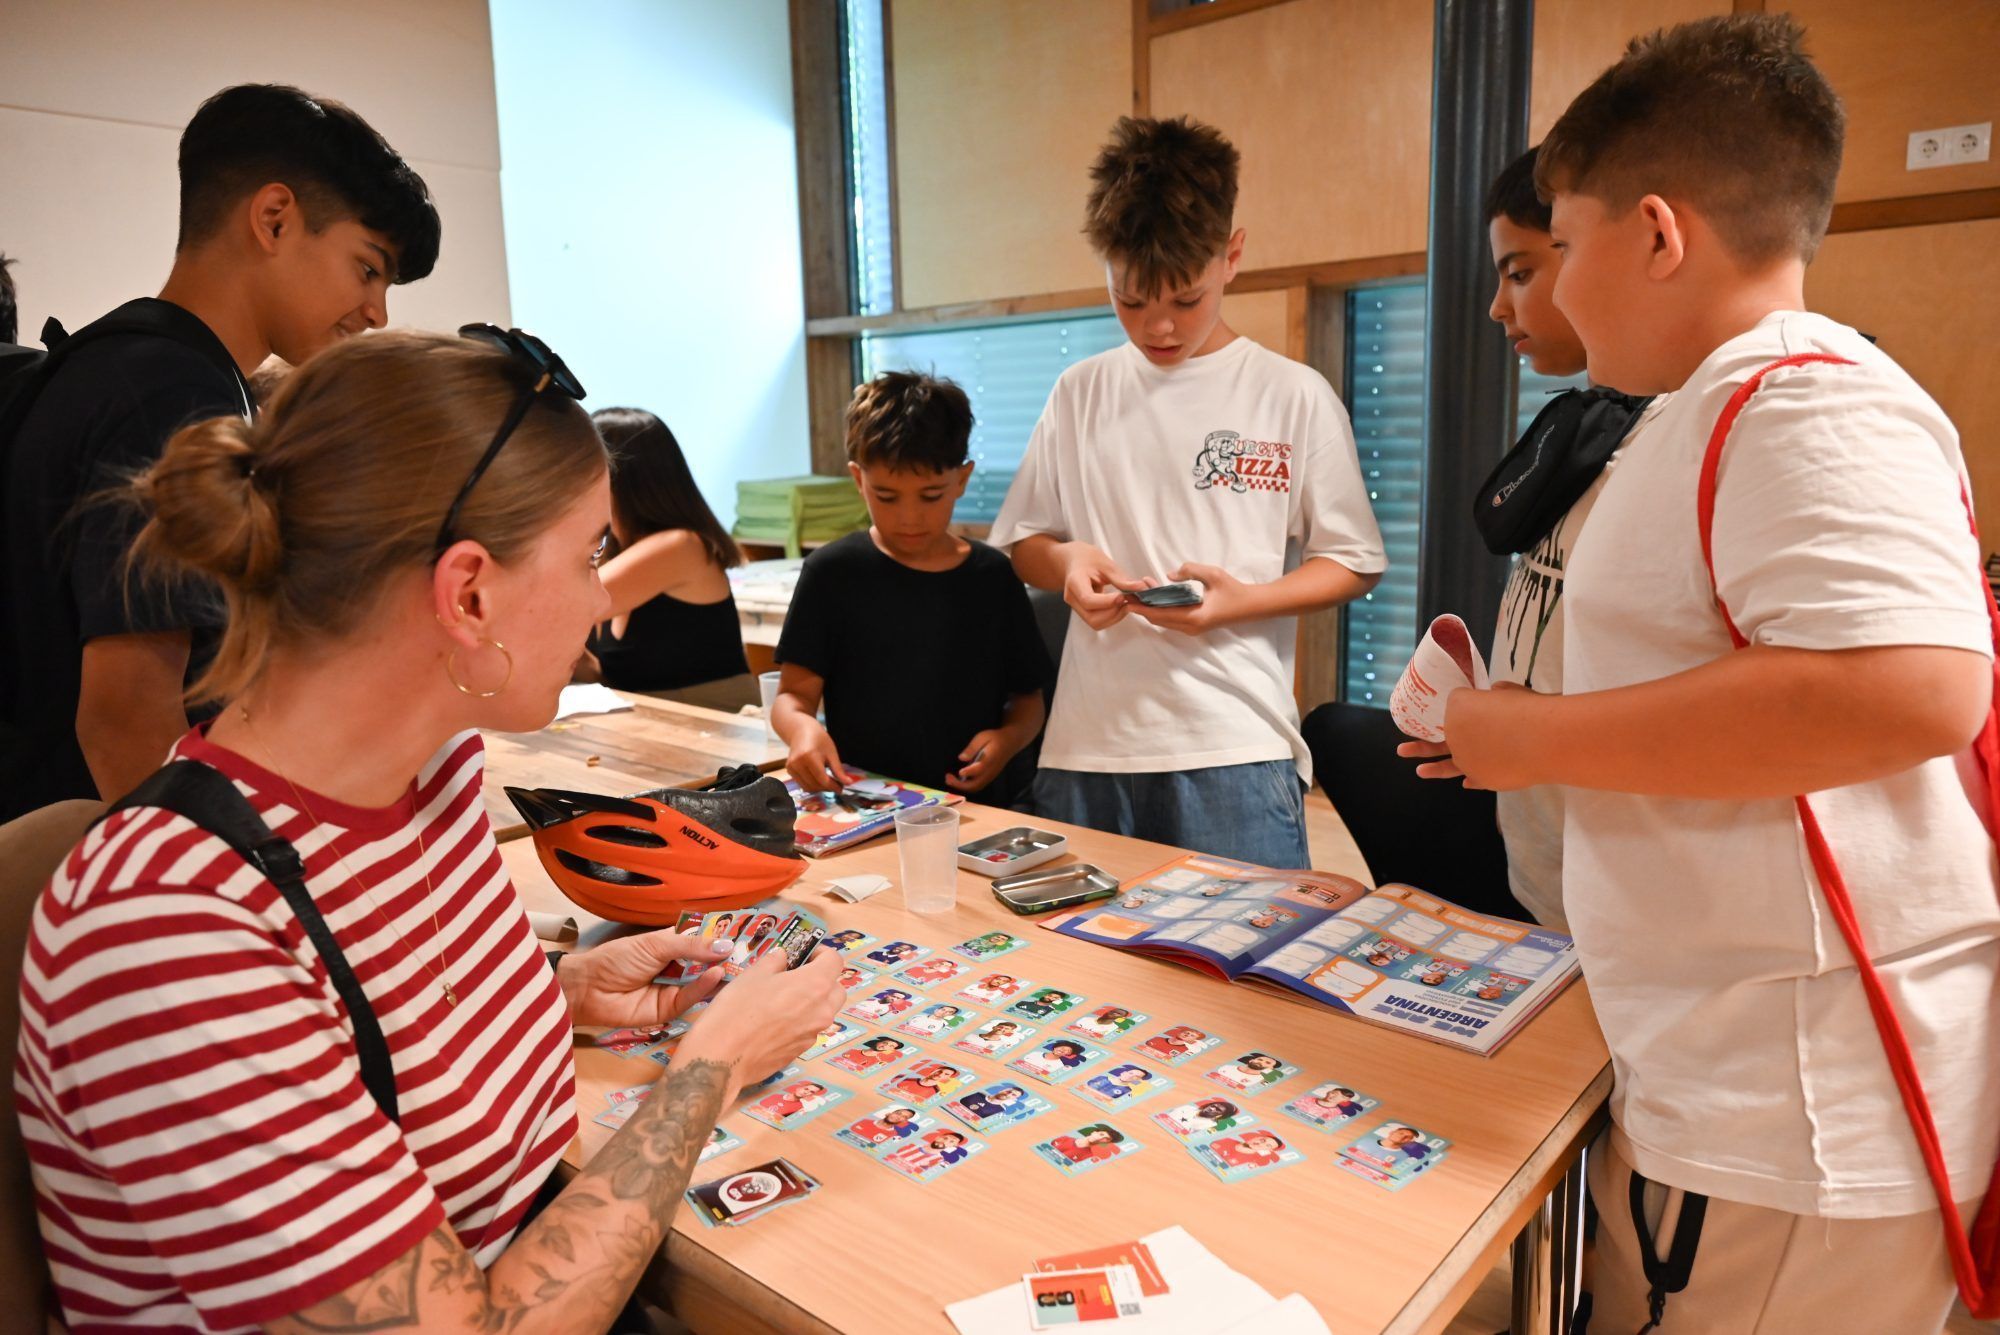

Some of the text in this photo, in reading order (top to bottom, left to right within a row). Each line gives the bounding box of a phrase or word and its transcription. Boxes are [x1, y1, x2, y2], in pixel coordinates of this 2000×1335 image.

[679, 825, 720, 850] ACTION
[1384, 994, 1490, 1029] ARGENTINA
[1429, 1020, 1478, 1038] WE
